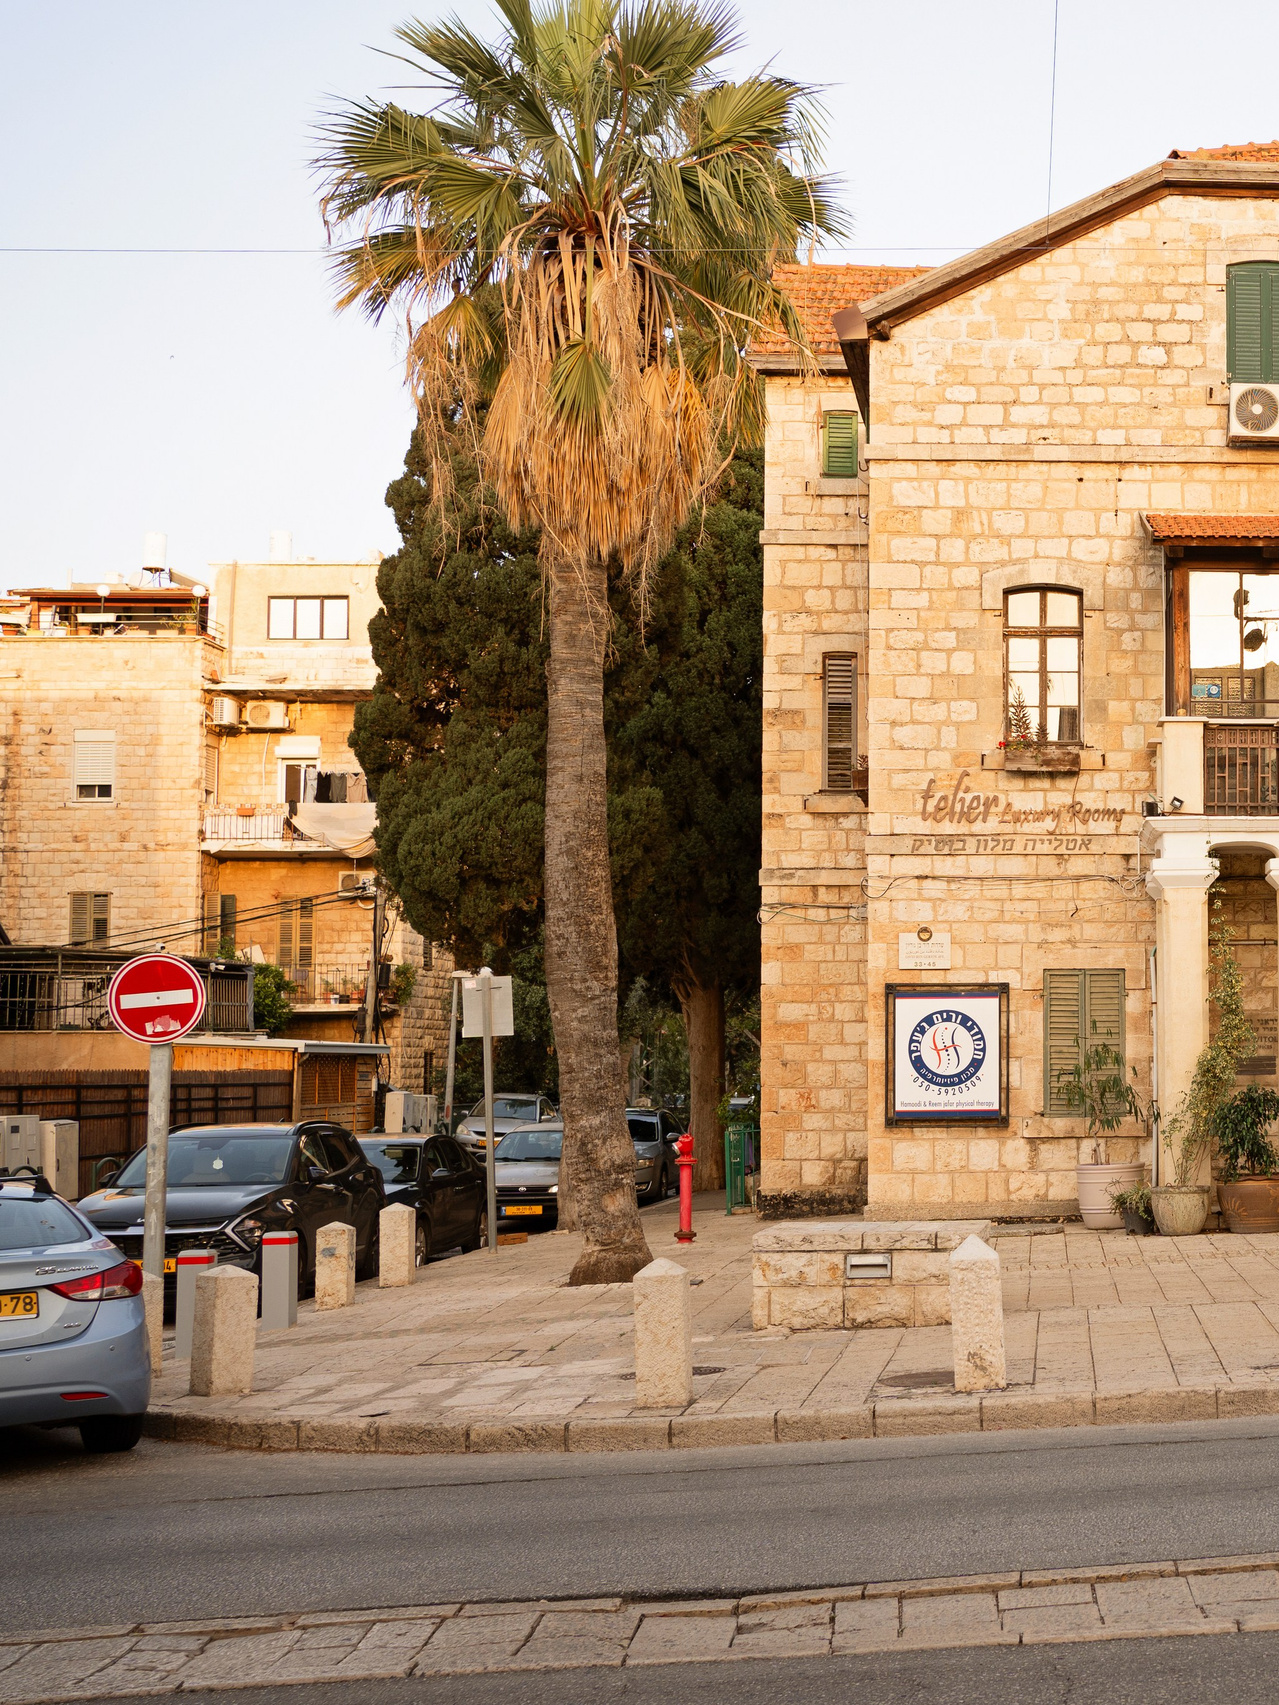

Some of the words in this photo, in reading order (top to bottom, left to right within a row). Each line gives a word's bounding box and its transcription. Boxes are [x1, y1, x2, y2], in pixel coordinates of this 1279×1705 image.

[998, 802, 1062, 834] Luxury
[1067, 801, 1126, 825] Rooms
[975, 837, 1015, 853] מלון
[1023, 837, 1093, 851] אטלייה
[932, 1012, 963, 1024] ורים
[966, 1020, 984, 1060] חמודי
[960, 1067, 975, 1081] מכון
[912, 1075, 982, 1096] 050-5920509
[956, 1100, 975, 1109] physical
[976, 1099, 995, 1108] therapy
